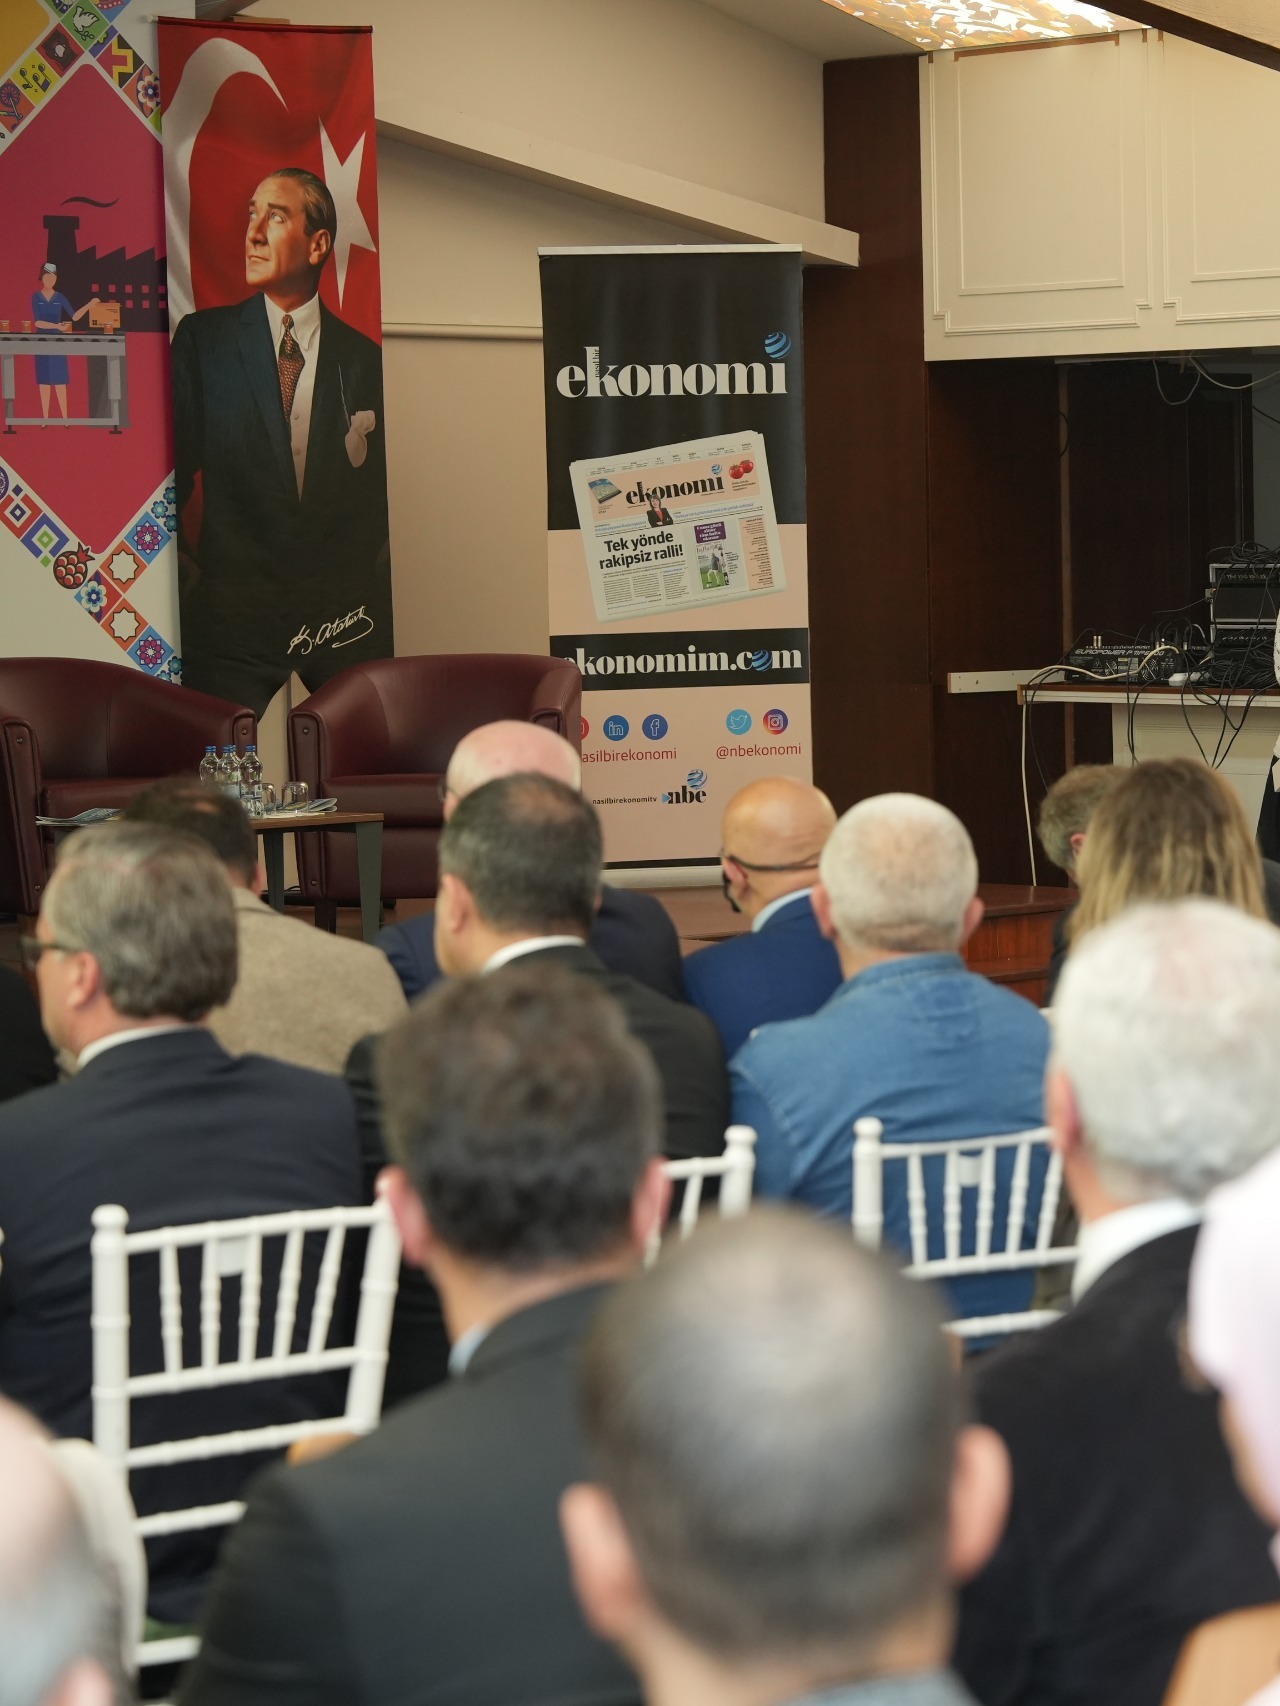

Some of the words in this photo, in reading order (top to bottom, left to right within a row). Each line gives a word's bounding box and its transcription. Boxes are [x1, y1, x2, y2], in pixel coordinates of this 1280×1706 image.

[556, 345, 788, 398] ekonomi
[626, 476, 724, 504] ekonomi
[604, 537, 629, 552] Tek
[630, 531, 674, 551] yönde
[599, 550, 652, 569] rakipsiz
[653, 544, 684, 560] ralli!
[582, 748, 677, 763] asilbirekonomi
[716, 743, 801, 759] @nbekonomi
[592, 796, 657, 804] nasilbirekonomitv
[667, 785, 707, 804] nbe
